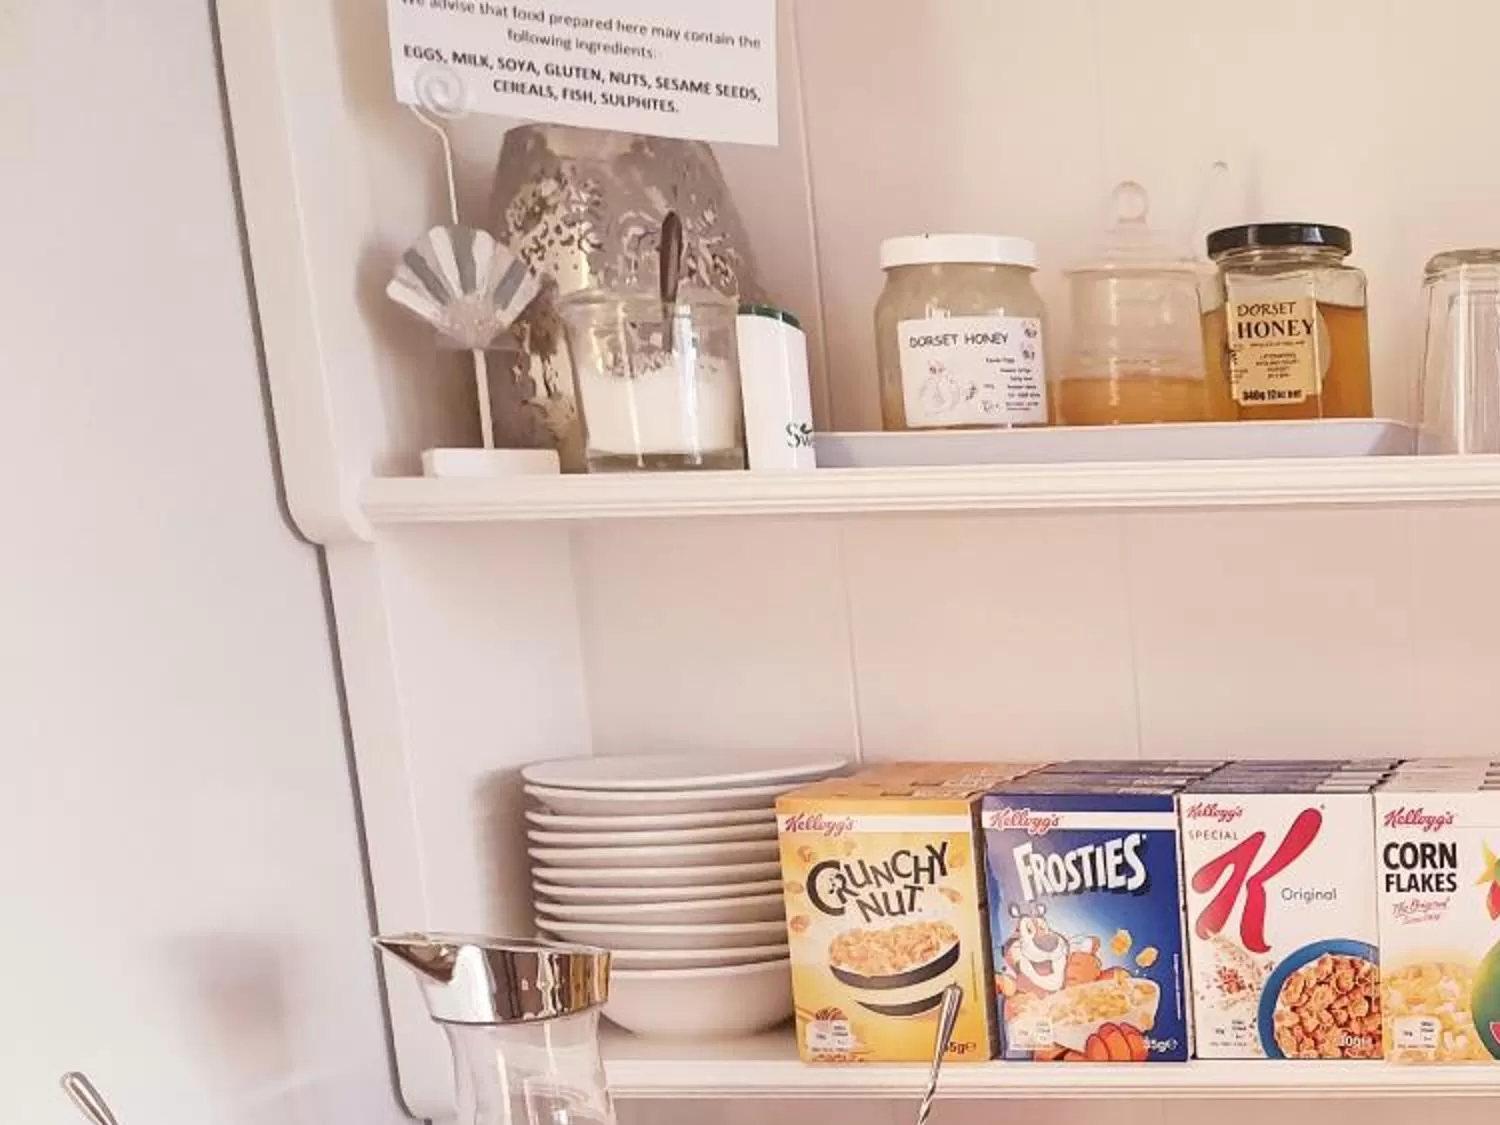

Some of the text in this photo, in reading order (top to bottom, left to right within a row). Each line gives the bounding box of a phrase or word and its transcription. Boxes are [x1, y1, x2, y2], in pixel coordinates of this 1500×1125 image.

[430, 0, 475, 15] advise
[479, 2, 508, 19] that
[513, 6, 545, 23] food
[549, 13, 613, 32] prepared
[617, 19, 648, 36] here
[651, 26, 681, 42] may
[684, 29, 735, 47] contain
[739, 35, 761, 49] the
[507, 28, 572, 52] following
[403, 44, 761, 103] EGGS, MILK, SOYA, GLUTEN, NUTS, SESAME SEEDS,
[493, 80, 679, 113] CEREALS, FISH, SULPHITES.
[1237, 301, 1297, 318] DORSET
[909, 332, 1009, 349] DORSET HONEY
[1237, 319, 1314, 339] HONEY
[990, 808, 1062, 834] Kellogg's
[1187, 802, 1243, 822] Kellogg's
[1384, 806, 1456, 832] Kellogg's
[785, 814, 856, 837] Kellogg's
[1188, 830, 1239, 841] SPECIAL
[1013, 833, 1147, 900] FROSTIES
[1383, 841, 1457, 870] CORN
[805, 841, 949, 917] CRUNCHY
[1192, 807, 1323, 954] K
[1385, 873, 1457, 893] FLAKES
[855, 885, 923, 923] NUT
[1281, 887, 1337, 902] Original
